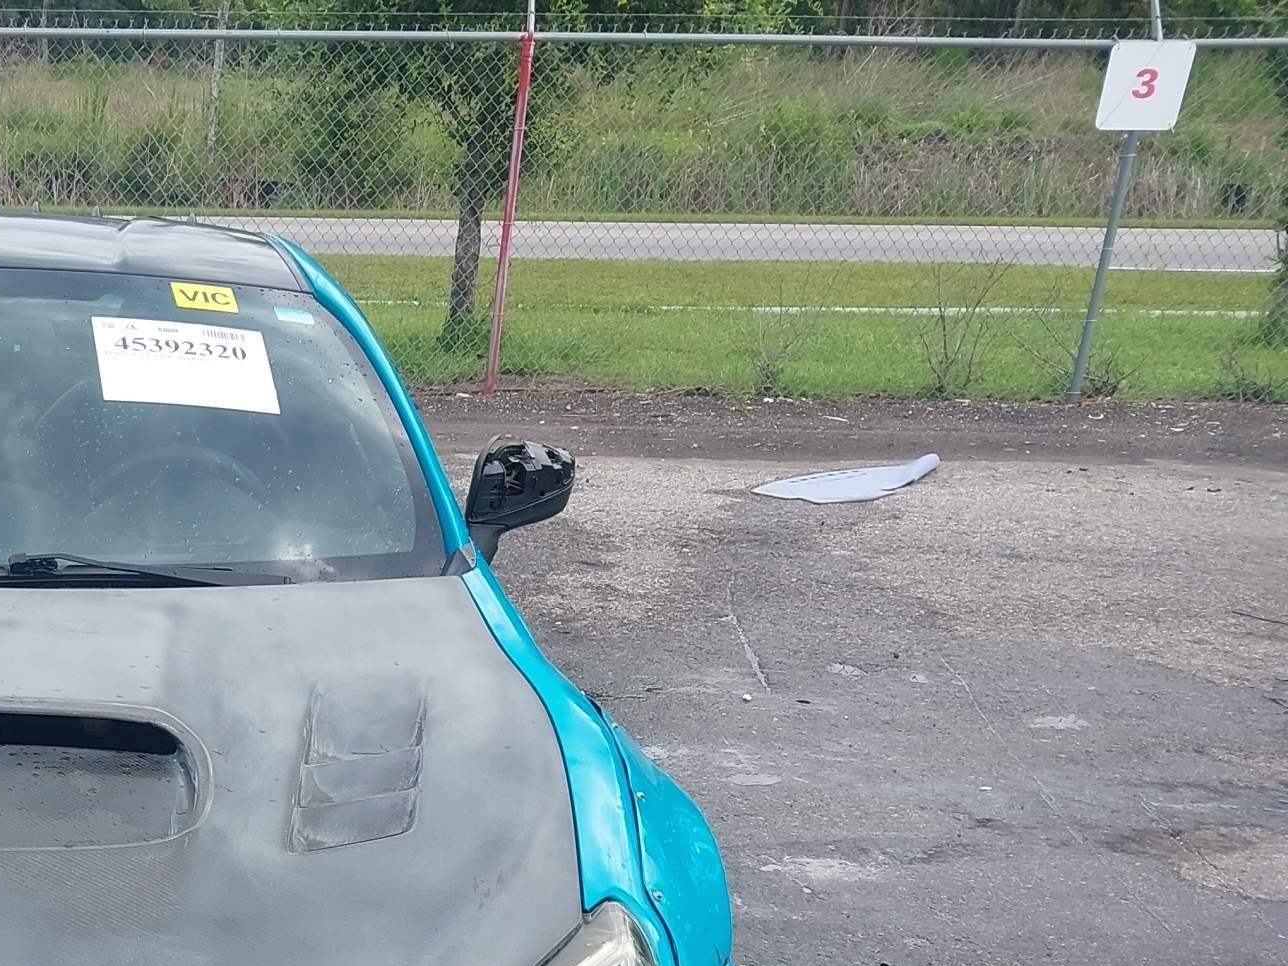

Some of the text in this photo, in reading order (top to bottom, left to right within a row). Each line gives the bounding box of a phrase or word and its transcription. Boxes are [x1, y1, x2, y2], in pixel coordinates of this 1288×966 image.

[1132, 68, 1159, 99] 3
[179, 288, 231, 306] VIC
[114, 335, 247, 361] 45392320
